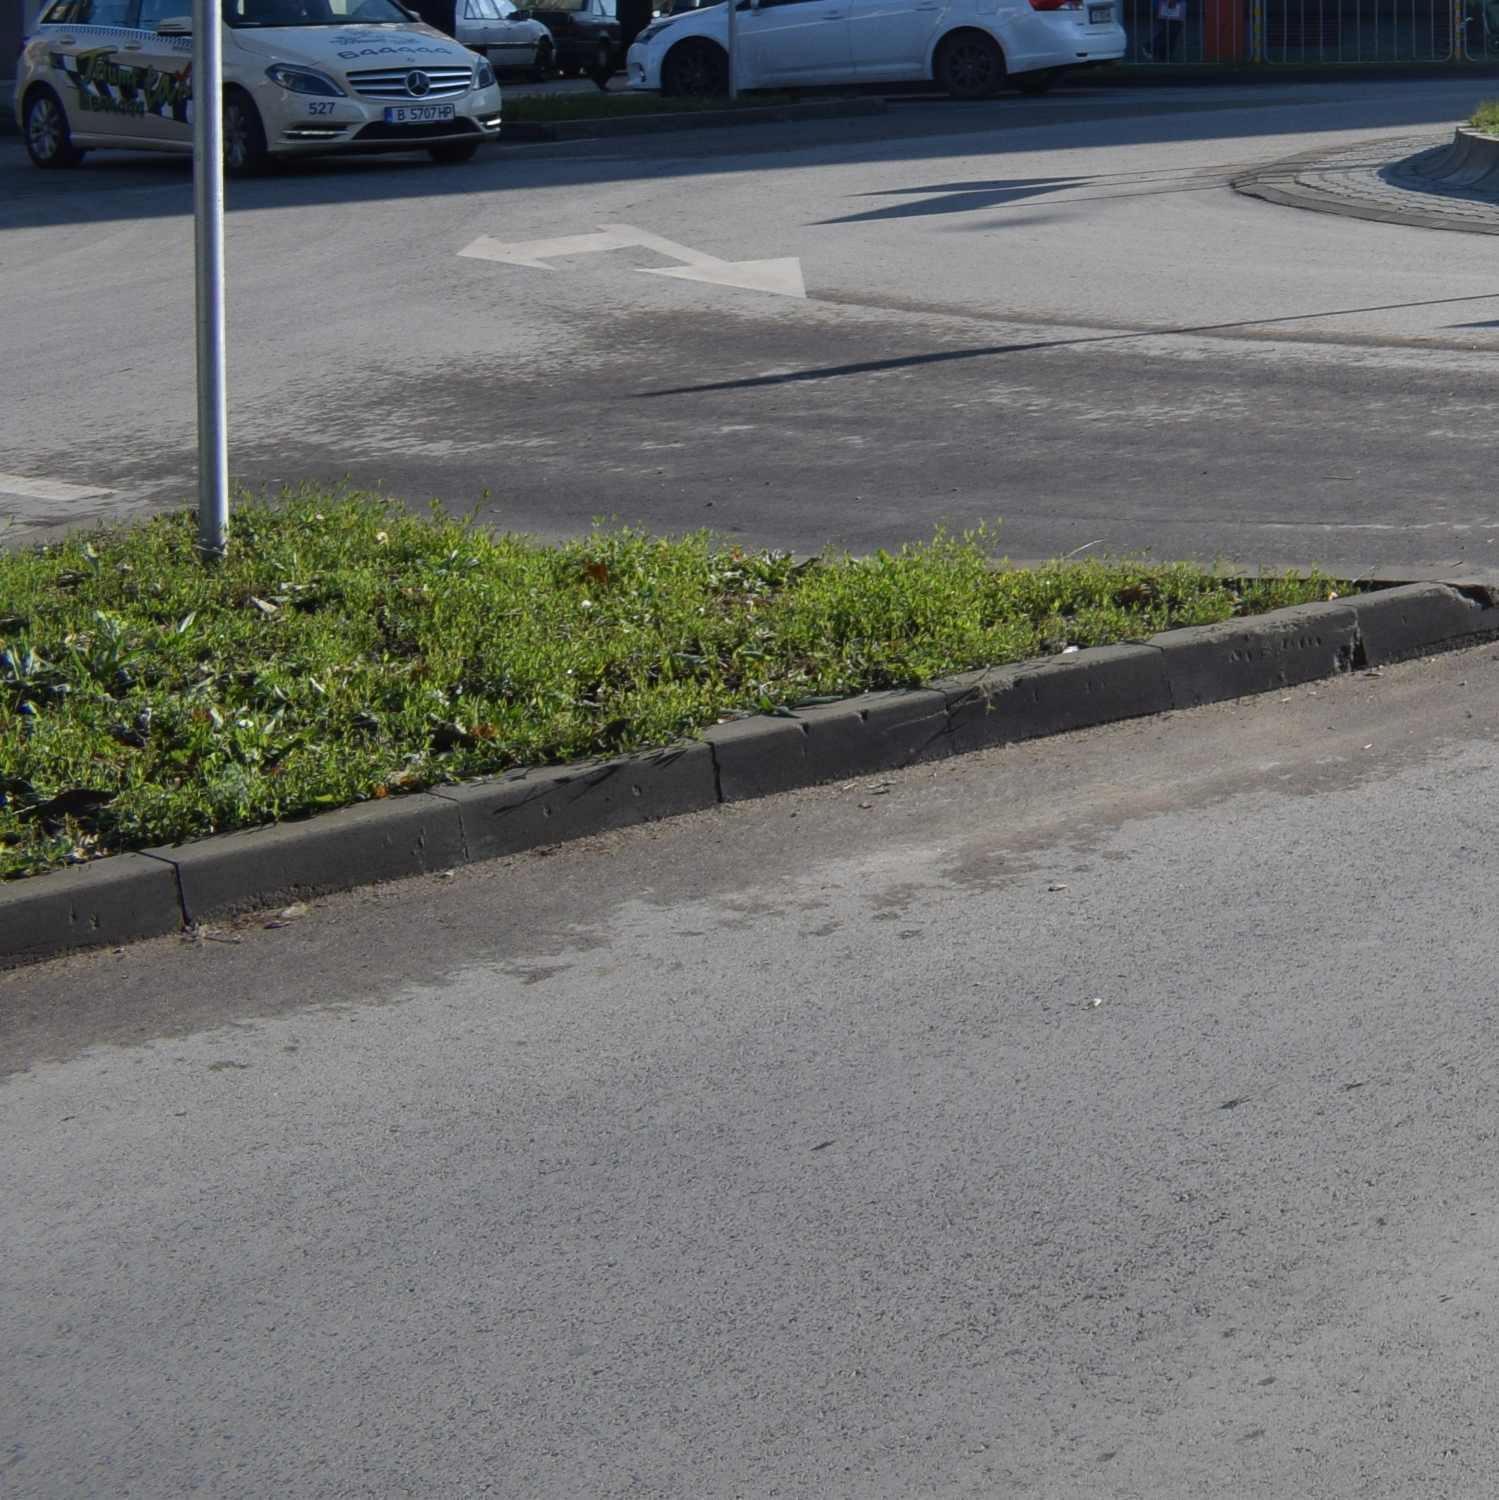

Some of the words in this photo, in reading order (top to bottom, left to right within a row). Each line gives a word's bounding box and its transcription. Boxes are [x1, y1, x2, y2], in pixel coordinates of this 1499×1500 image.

[337, 46, 453, 60] 644444
[308, 102, 336, 115] 527
[410, 107, 437, 120] 5707
